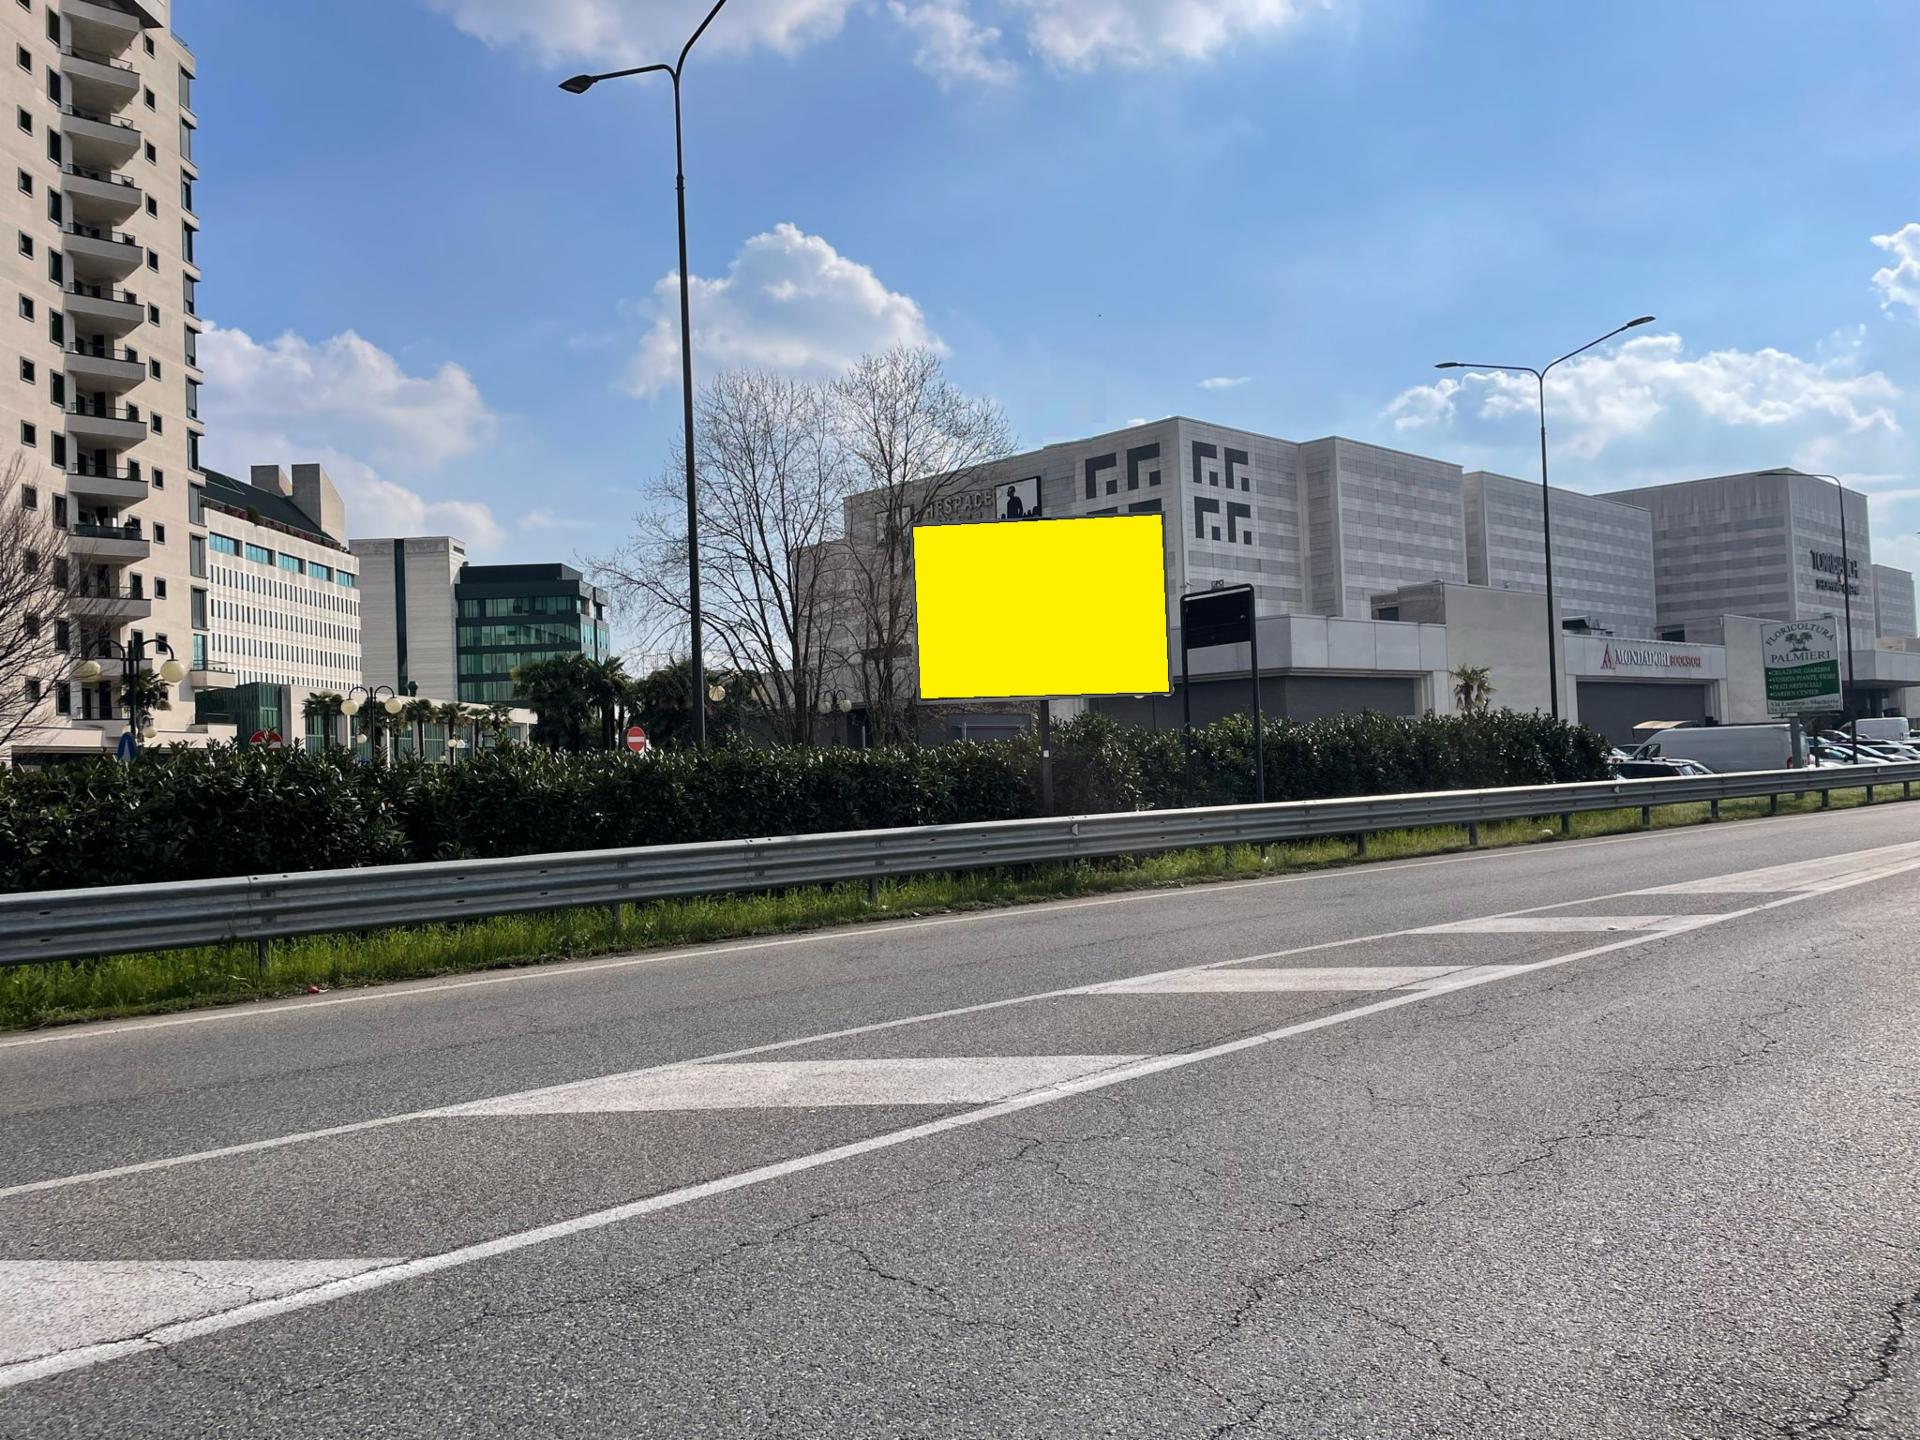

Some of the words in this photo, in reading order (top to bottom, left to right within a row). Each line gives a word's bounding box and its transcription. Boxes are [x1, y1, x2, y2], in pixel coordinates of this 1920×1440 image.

[1765, 623, 1834, 646] FLORICOLTURA
[1615, 649, 1670, 667] MONDADORI
[1770, 650, 1831, 664] PALMIERI
